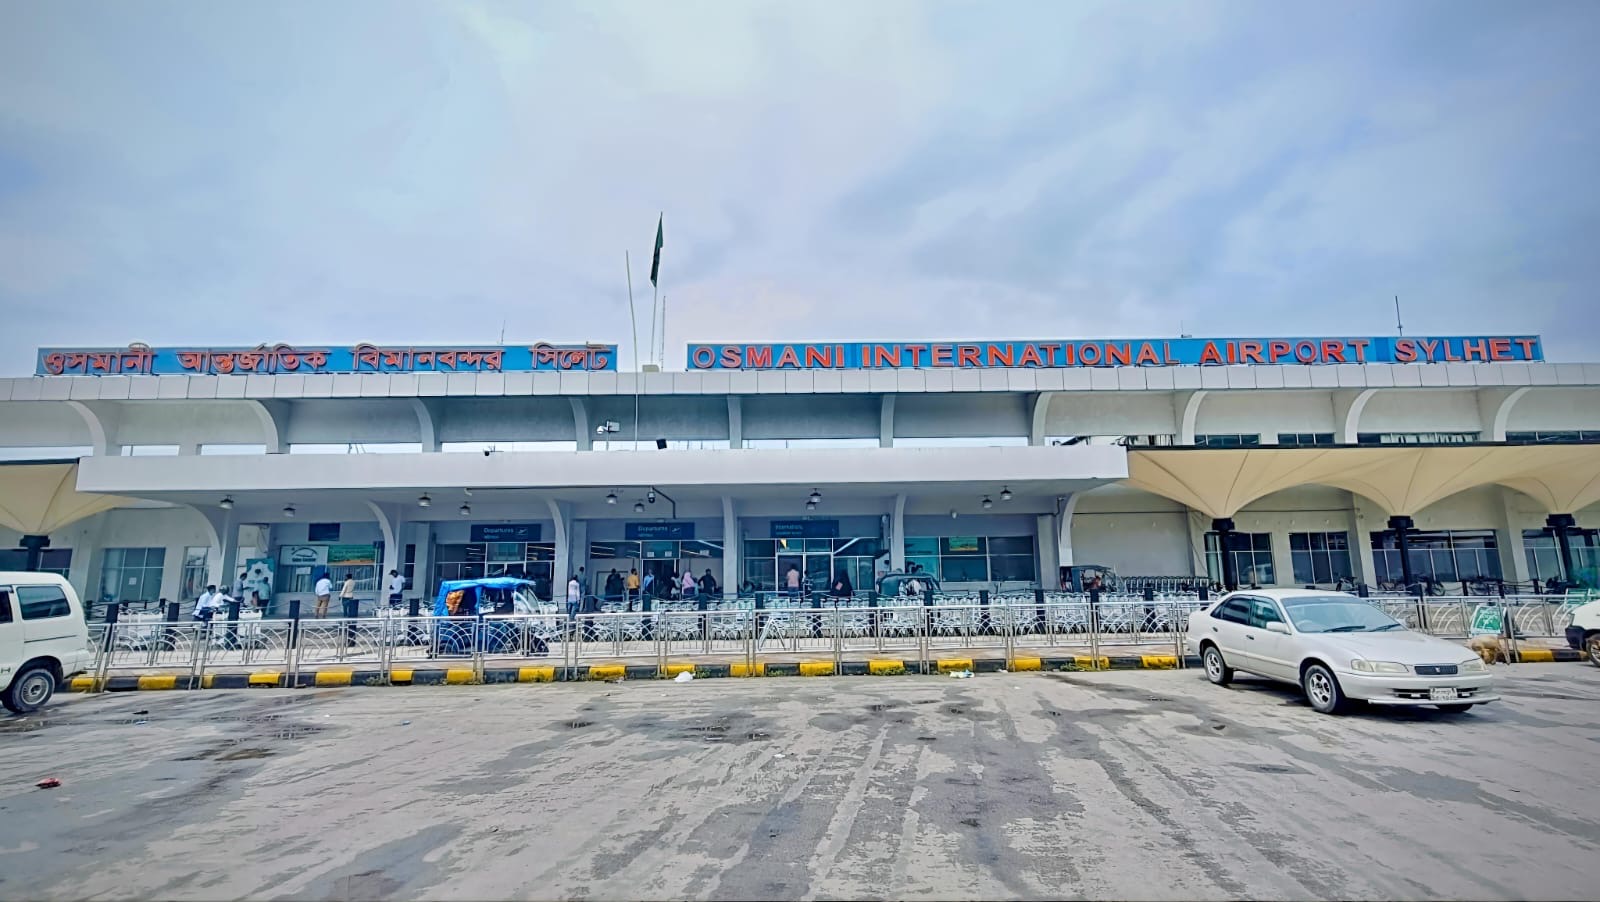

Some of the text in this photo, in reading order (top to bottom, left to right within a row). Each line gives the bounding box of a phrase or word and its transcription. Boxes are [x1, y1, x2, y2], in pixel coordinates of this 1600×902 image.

[42, 341, 611, 375] ওসমানী আন্তর্জাতিক বিমানবন্দর সিলেট
[692, 337, 1537, 368] OSMANI INTERNATIONAL AIRPORT SYLHET
